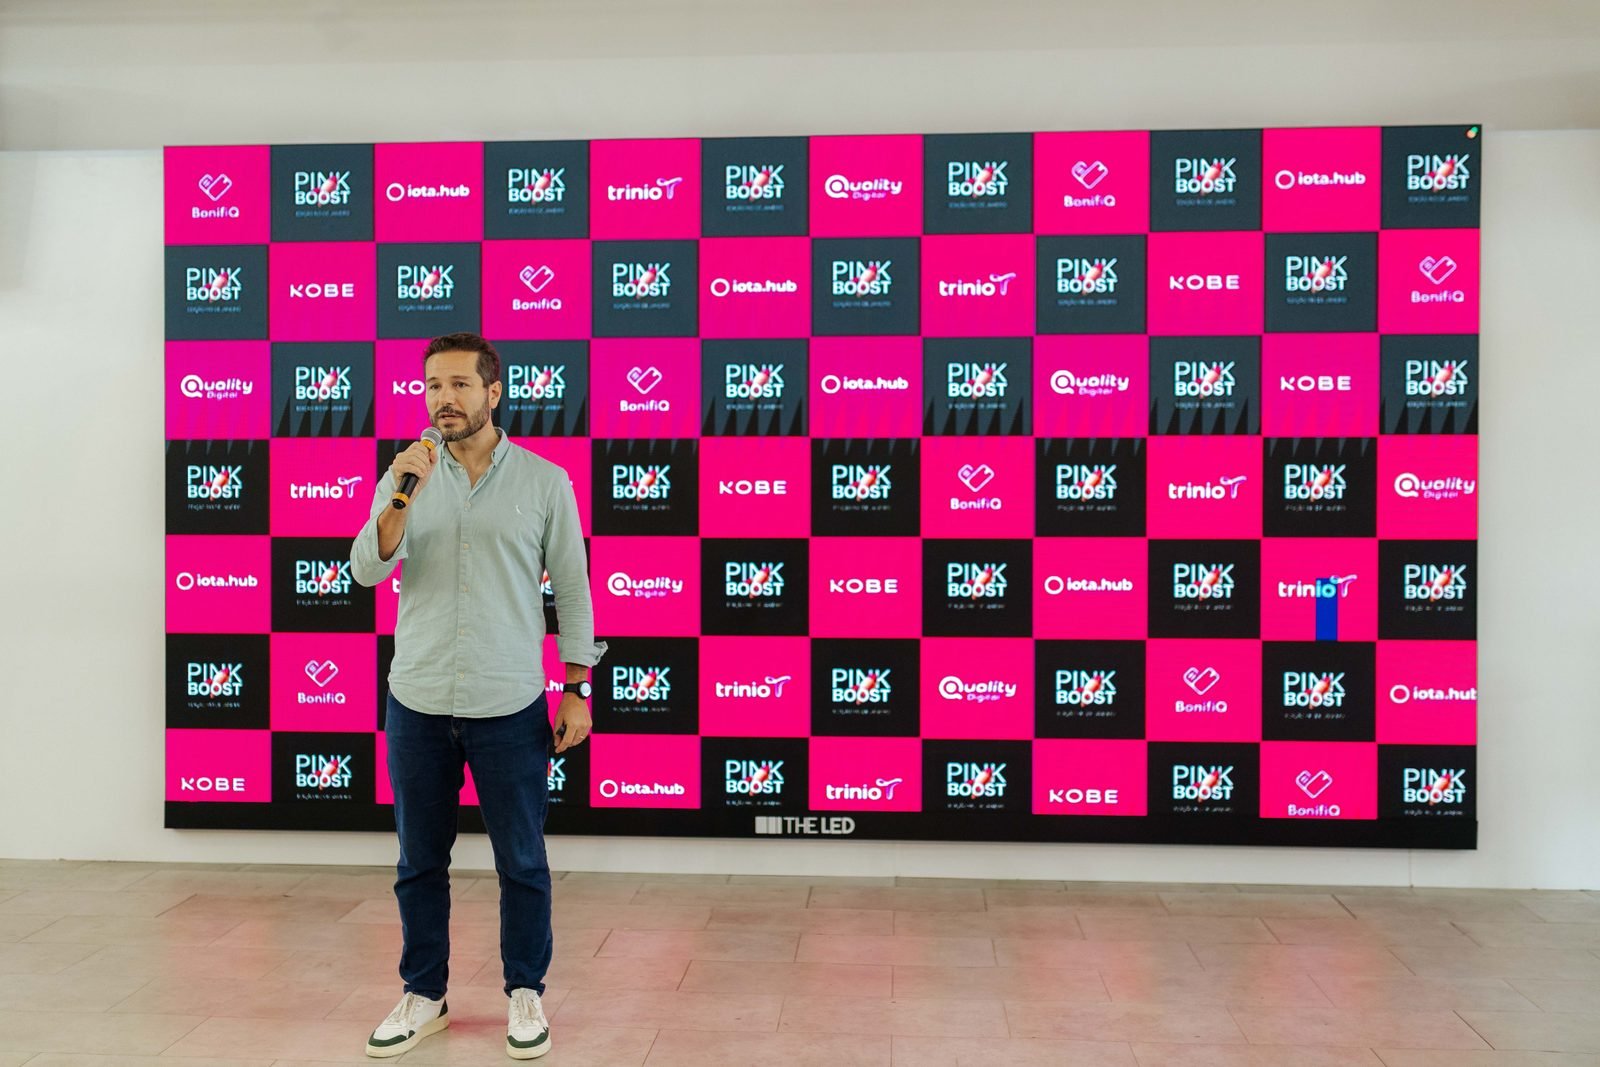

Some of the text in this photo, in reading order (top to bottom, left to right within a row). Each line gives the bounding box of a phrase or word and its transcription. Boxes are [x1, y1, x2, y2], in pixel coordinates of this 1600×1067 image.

[1298, 172, 1365, 185] iota.hub
[1408, 175, 1469, 190] BOOST
[407, 184, 470, 198] iota.hub
[726, 185, 784, 199] BOOST
[825, 175, 902, 199] Quality
[949, 182, 1008, 196] BOOST
[1176, 179, 1236, 193] BOOST
[295, 191, 350, 205] BOOST
[508, 188, 565, 202] BOOST
[1064, 195, 1115, 207] BonifiQ
[192, 207, 239, 218] BonifiQ
[732, 279, 797, 293] iota.hub
[833, 281, 891, 295] BOOST
[1057, 279, 1118, 293] BOOST
[1170, 275, 1239, 290] KOBE
[1286, 277, 1347, 292] BOOST
[187, 286, 241, 300] BOOST
[290, 284, 354, 298] KOBE
[398, 285, 454, 299] BOOST
[613, 283, 670, 297] BOOST
[1411, 291, 1464, 302] BonifiQ
[513, 299, 561, 310] BonifiQ
[181, 375, 252, 398] Quality
[393, 379, 425, 395] KO
[843, 377, 908, 391] iota.hub
[1050, 370, 1129, 395] Quality
[1175, 382, 1235, 397] BOOST
[1281, 376, 1351, 391] KOBE
[1406, 381, 1468, 396] BOOST
[296, 387, 351, 401] BOOST
[509, 386, 566, 400] BOOST
[726, 385, 784, 399] BOOST
[948, 384, 1008, 398] BOOST
[620, 400, 669, 411] BonifiQ
[188, 485, 242, 499] BOOST
[613, 484, 670, 498] BOOST
[719, 480, 786, 494] KOBE
[1057, 485, 1117, 499] BOOST
[1285, 485, 1346, 500] BOOST
[1395, 473, 1475, 498] Quality
[833, 486, 891, 500] BOOST
[951, 498, 1001, 509] BonifiQ
[197, 574, 258, 586] iota.hub
[295, 580, 351, 594] BOOST
[607, 572, 683, 596] Quality
[830, 579, 897, 593] KOBE
[1067, 577, 1133, 591] iota.hub
[726, 582, 784, 596] BOOST
[948, 583, 1007, 597] BOOST
[1174, 584, 1234, 598] BOOST
[1405, 585, 1466, 599] BOOST
[188, 683, 242, 697] BOOST
[613, 687, 670, 701] BOOST
[832, 688, 891, 702] BOOST
[939, 676, 1016, 700] Quality
[298, 692, 345, 704] BonifiQ
[1056, 691, 1116, 705] BOOST
[1284, 693, 1345, 707] BOOST
[1176, 701, 1227, 712] BonifiQ
[181, 777, 244, 791] KOBE
[296, 775, 352, 789] BOOST
[621, 782, 684, 794] iota.hub
[726, 779, 784, 793] BOOST
[947, 782, 1006, 796] BOOST
[1049, 789, 1118, 803] KOBE
[1173, 786, 1233, 801] BOOST
[1404, 789, 1465, 803] BOOST
[1288, 804, 1340, 816] BonifiQ
[784, 816, 856, 834] THE LED
